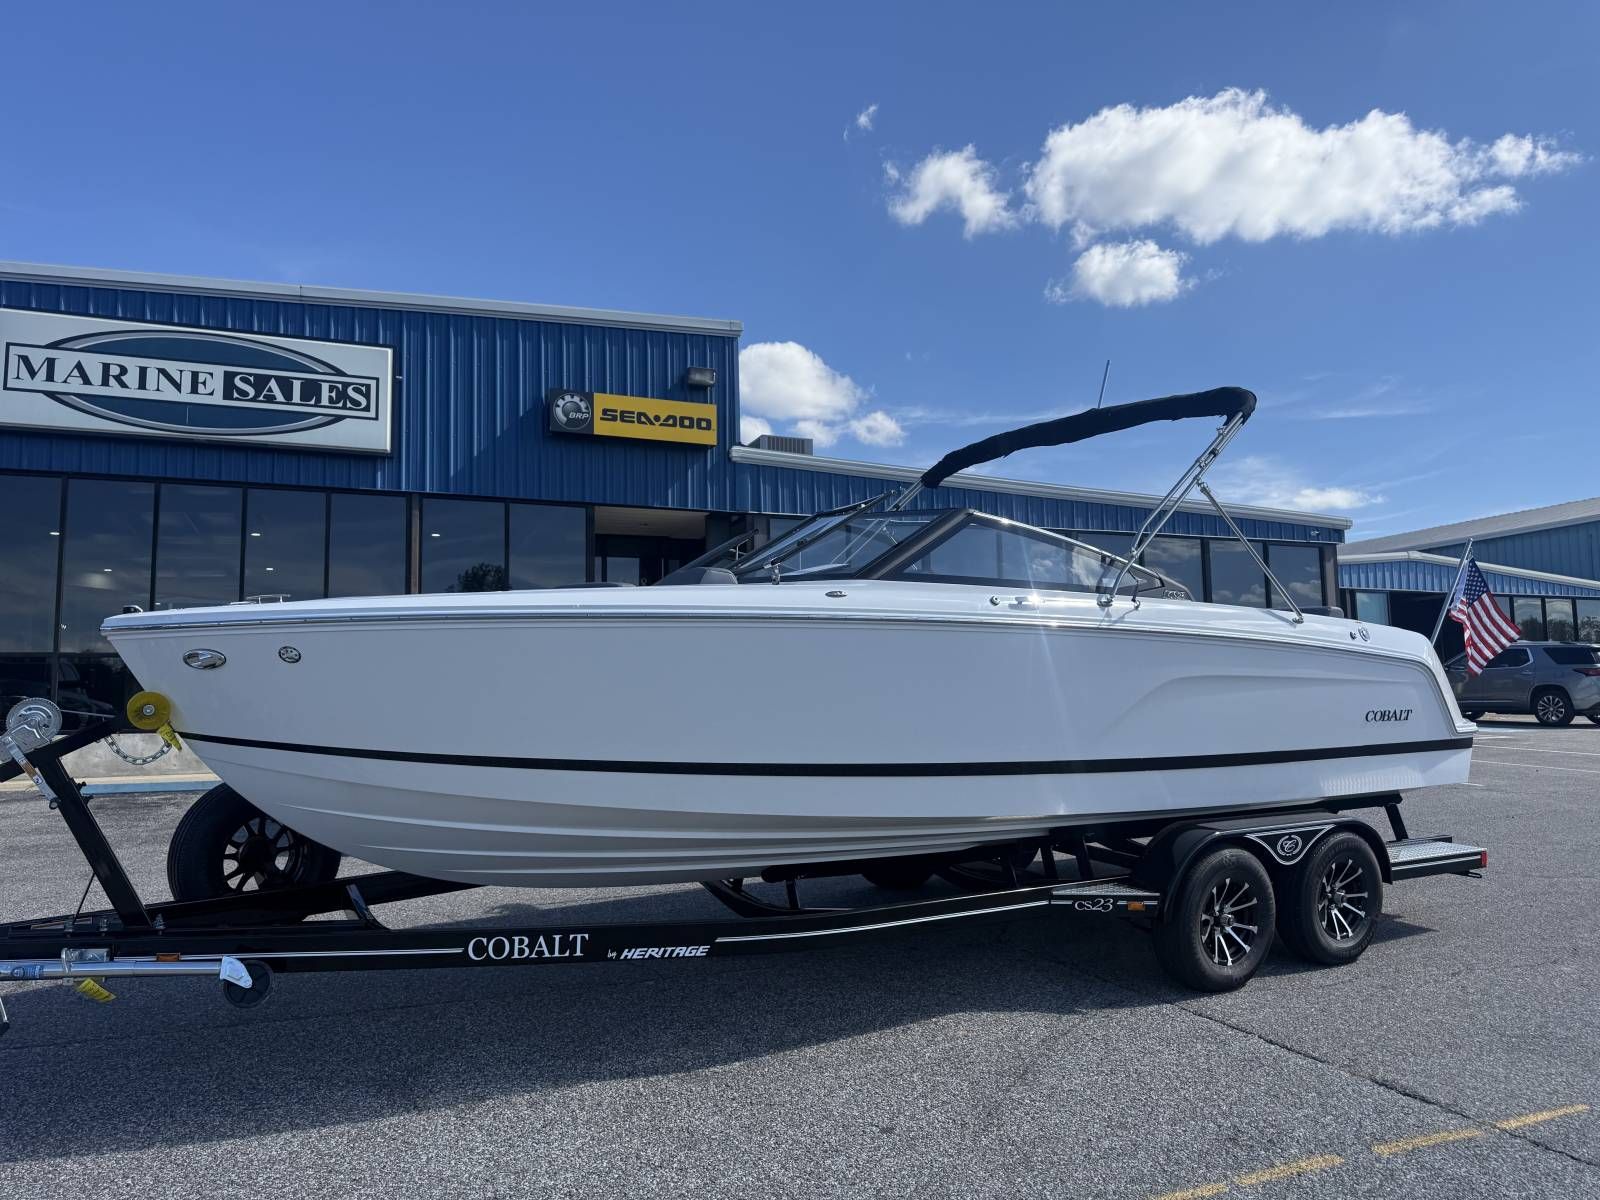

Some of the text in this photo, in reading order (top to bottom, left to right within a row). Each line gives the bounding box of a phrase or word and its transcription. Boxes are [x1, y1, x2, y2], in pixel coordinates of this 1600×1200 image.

[12, 353, 368, 411] MARINE SALES
[569, 411, 589, 419] BRP
[1365, 709, 1413, 722] COBALT
[468, 933, 589, 961] COBALT
[620, 945, 710, 960] HERITAGE
